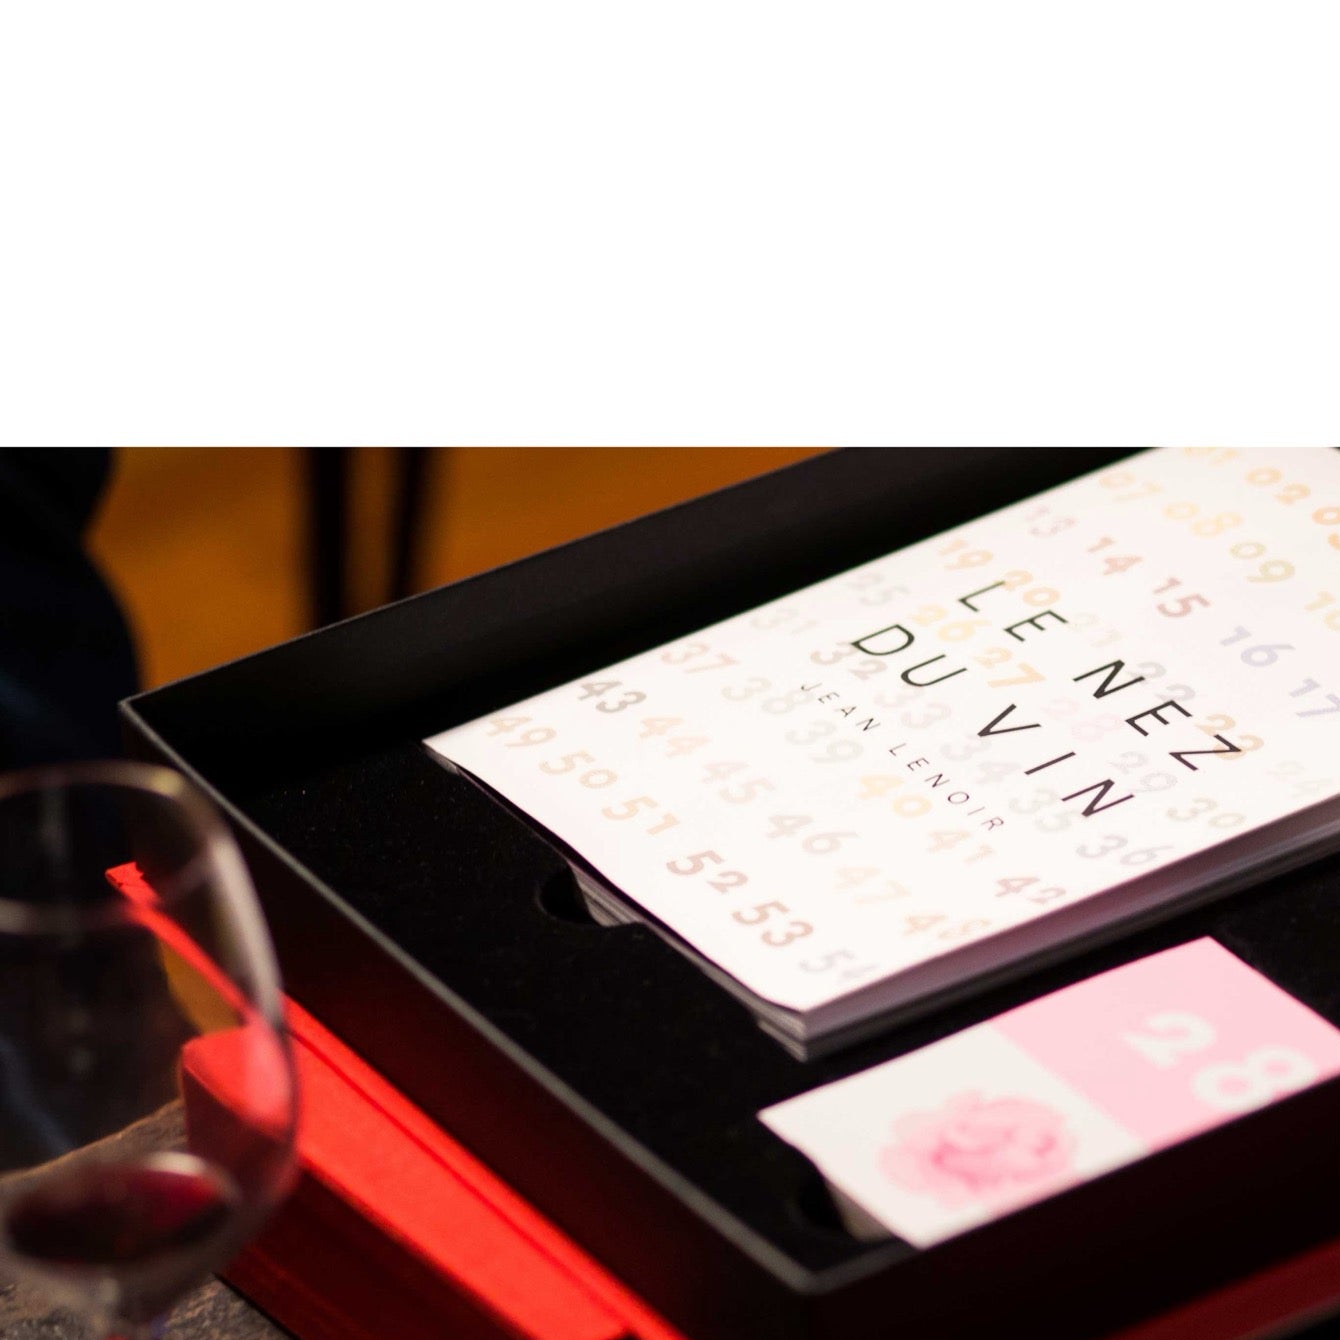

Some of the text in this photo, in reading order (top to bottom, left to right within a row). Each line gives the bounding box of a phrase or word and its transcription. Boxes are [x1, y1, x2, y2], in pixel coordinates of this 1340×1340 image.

[1099, 470, 1166, 502] 07
[1162, 501, 1244, 538] 08
[1229, 541, 1296, 583] 09
[1244, 466, 1311, 505] 02
[935, 538, 994, 572] 19
[998, 569, 1061, 607] 20
[1125, 661, 1196, 704] 22
[956, 579, 1243, 771] LE NEZ
[1024, 505, 1078, 538] 13
[1086, 535, 1144, 575] 14
[1152, 576, 1212, 618] 15
[1219, 625, 1296, 667] 16
[577, 680, 647, 713] 43
[638, 716, 712, 758] 44
[700, 761, 776, 804] 45
[766, 814, 861, 854] 46
[832, 864, 912, 906] 47
[660, 641, 1067, 905] 37 38 39 40 41 42
[800, 682, 1005, 831] JEAN LENOIR
[809, 641, 888, 680] 32
[939, 733, 1021, 785] 34
[1076, 834, 1175, 865] 36
[849, 623, 1136, 818] DU VIN
[908, 603, 993, 642] 26
[971, 646, 1046, 688] 27
[1106, 751, 1178, 793] 29
[1165, 795, 1246, 828] 30
[486, 715, 557, 747] 49
[538, 749, 619, 789] 50
[600, 796, 681, 836] 51
[665, 850, 748, 894] 52
[730, 900, 814, 947] 53
[1120, 1012, 1317, 1112] 28
